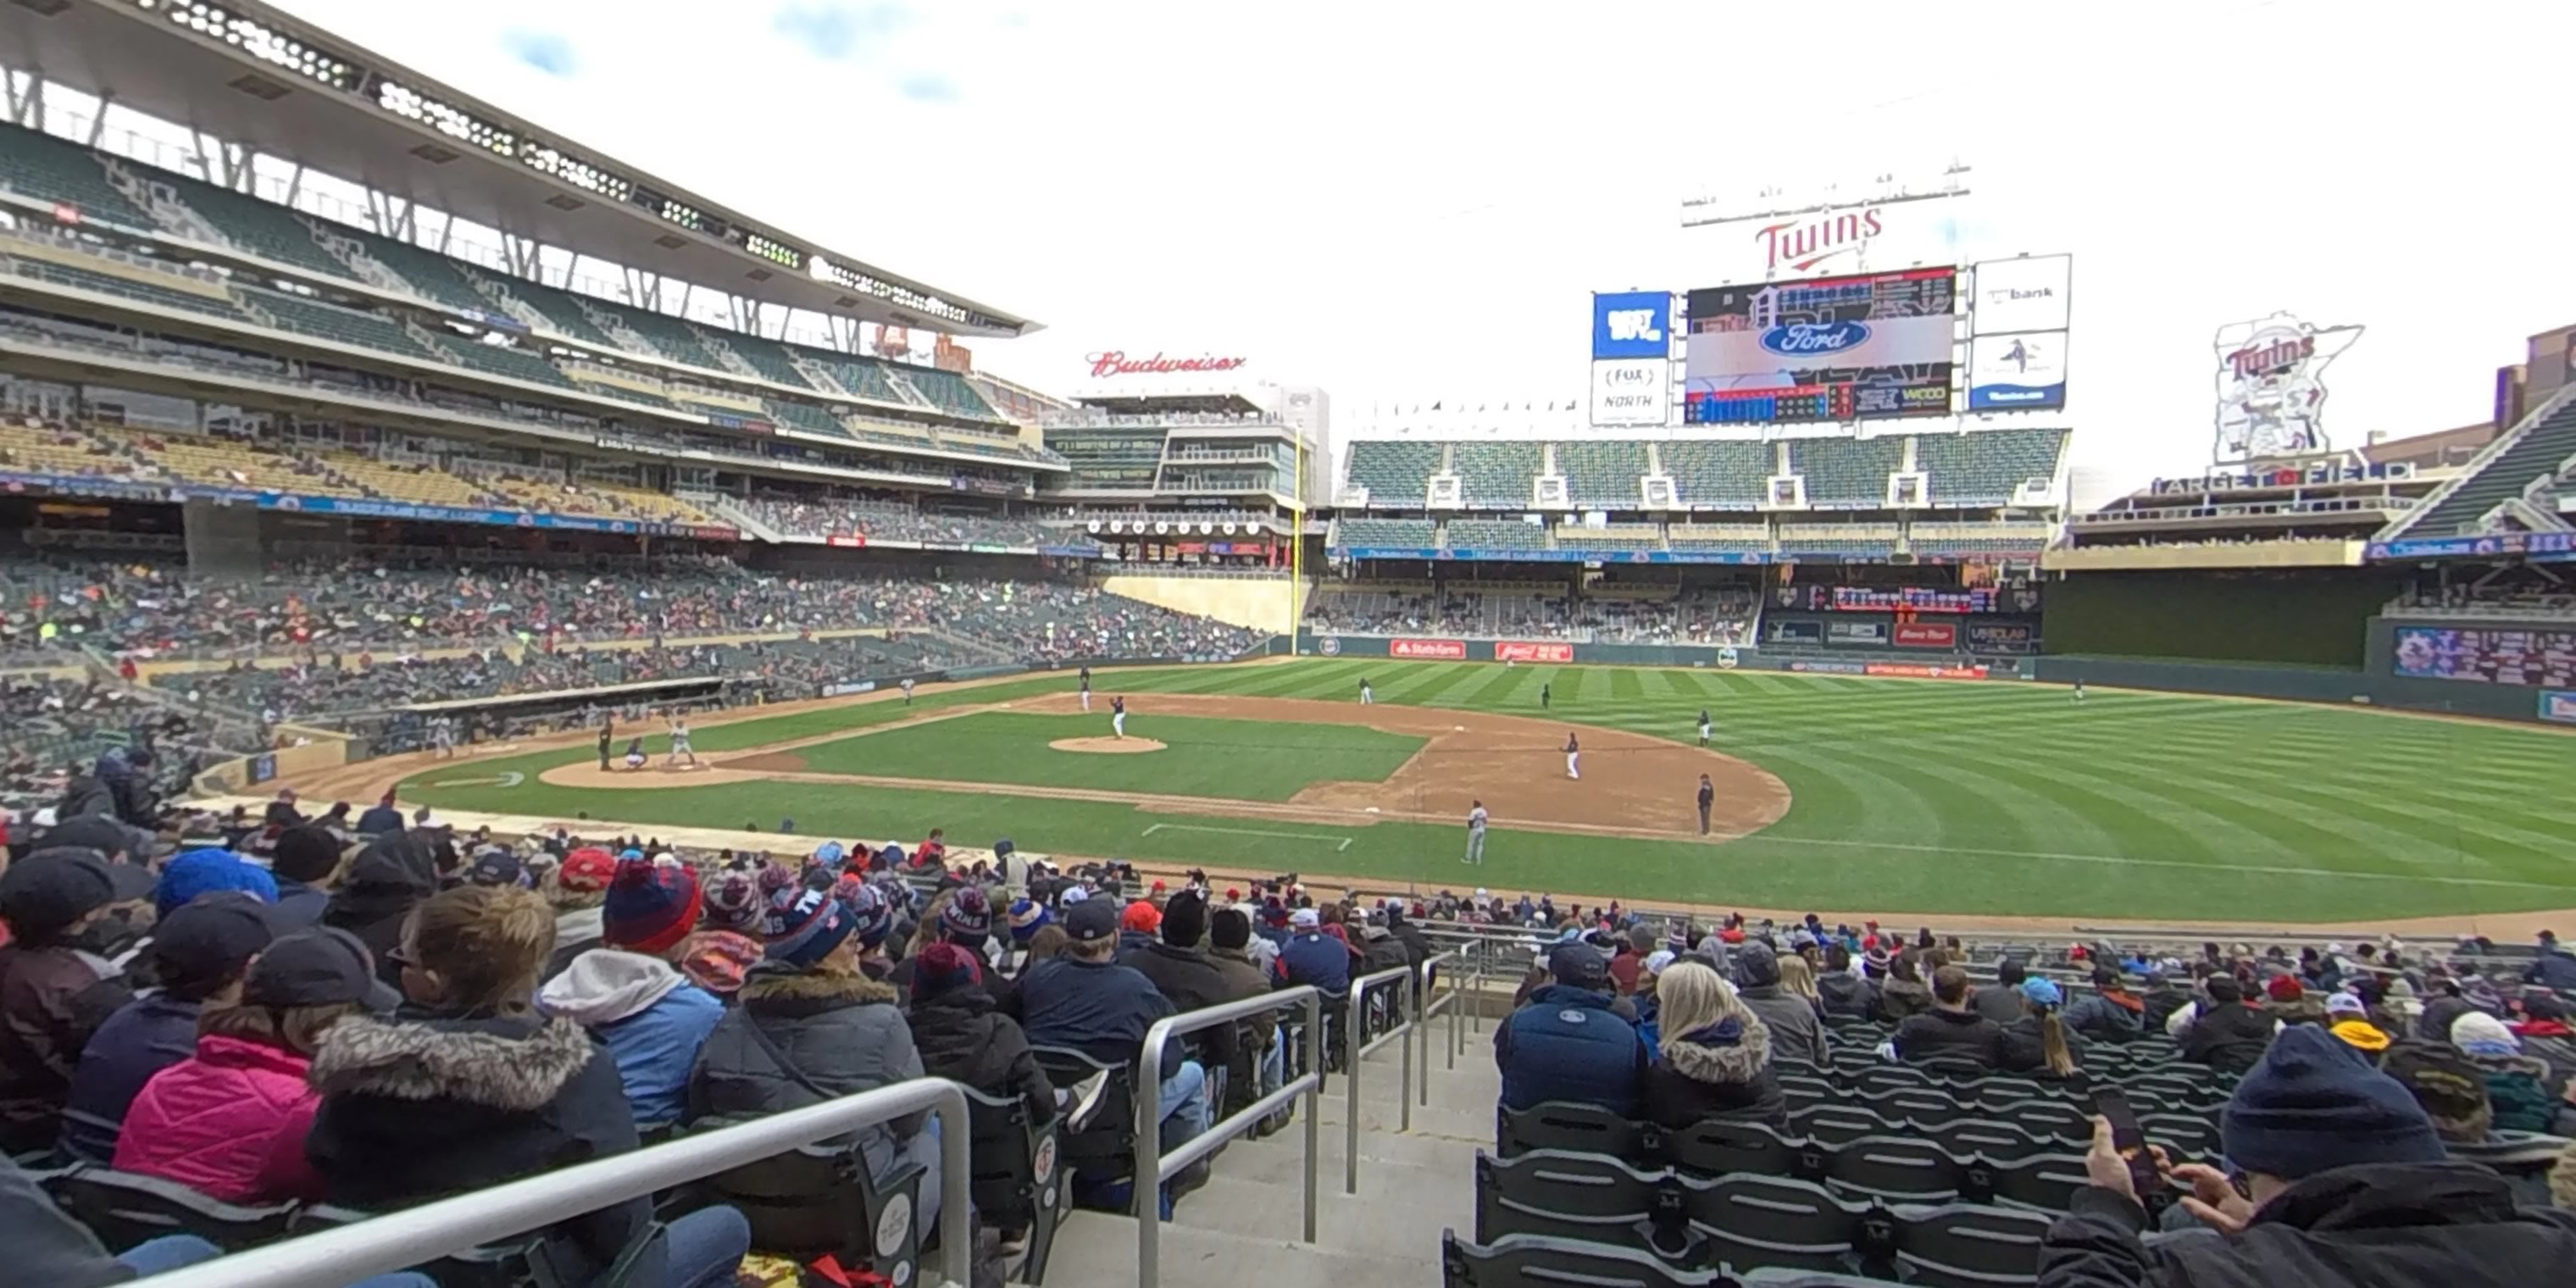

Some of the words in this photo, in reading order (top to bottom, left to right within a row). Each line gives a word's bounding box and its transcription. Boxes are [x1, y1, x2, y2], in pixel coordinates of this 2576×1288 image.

[1755, 208, 1881, 269] Twins
[1781, 323, 1846, 350] Ford
[1085, 350, 1246, 379] Budweiser
[2225, 336, 2315, 382] Twins
[2305, 462, 2416, 485] FIELD
